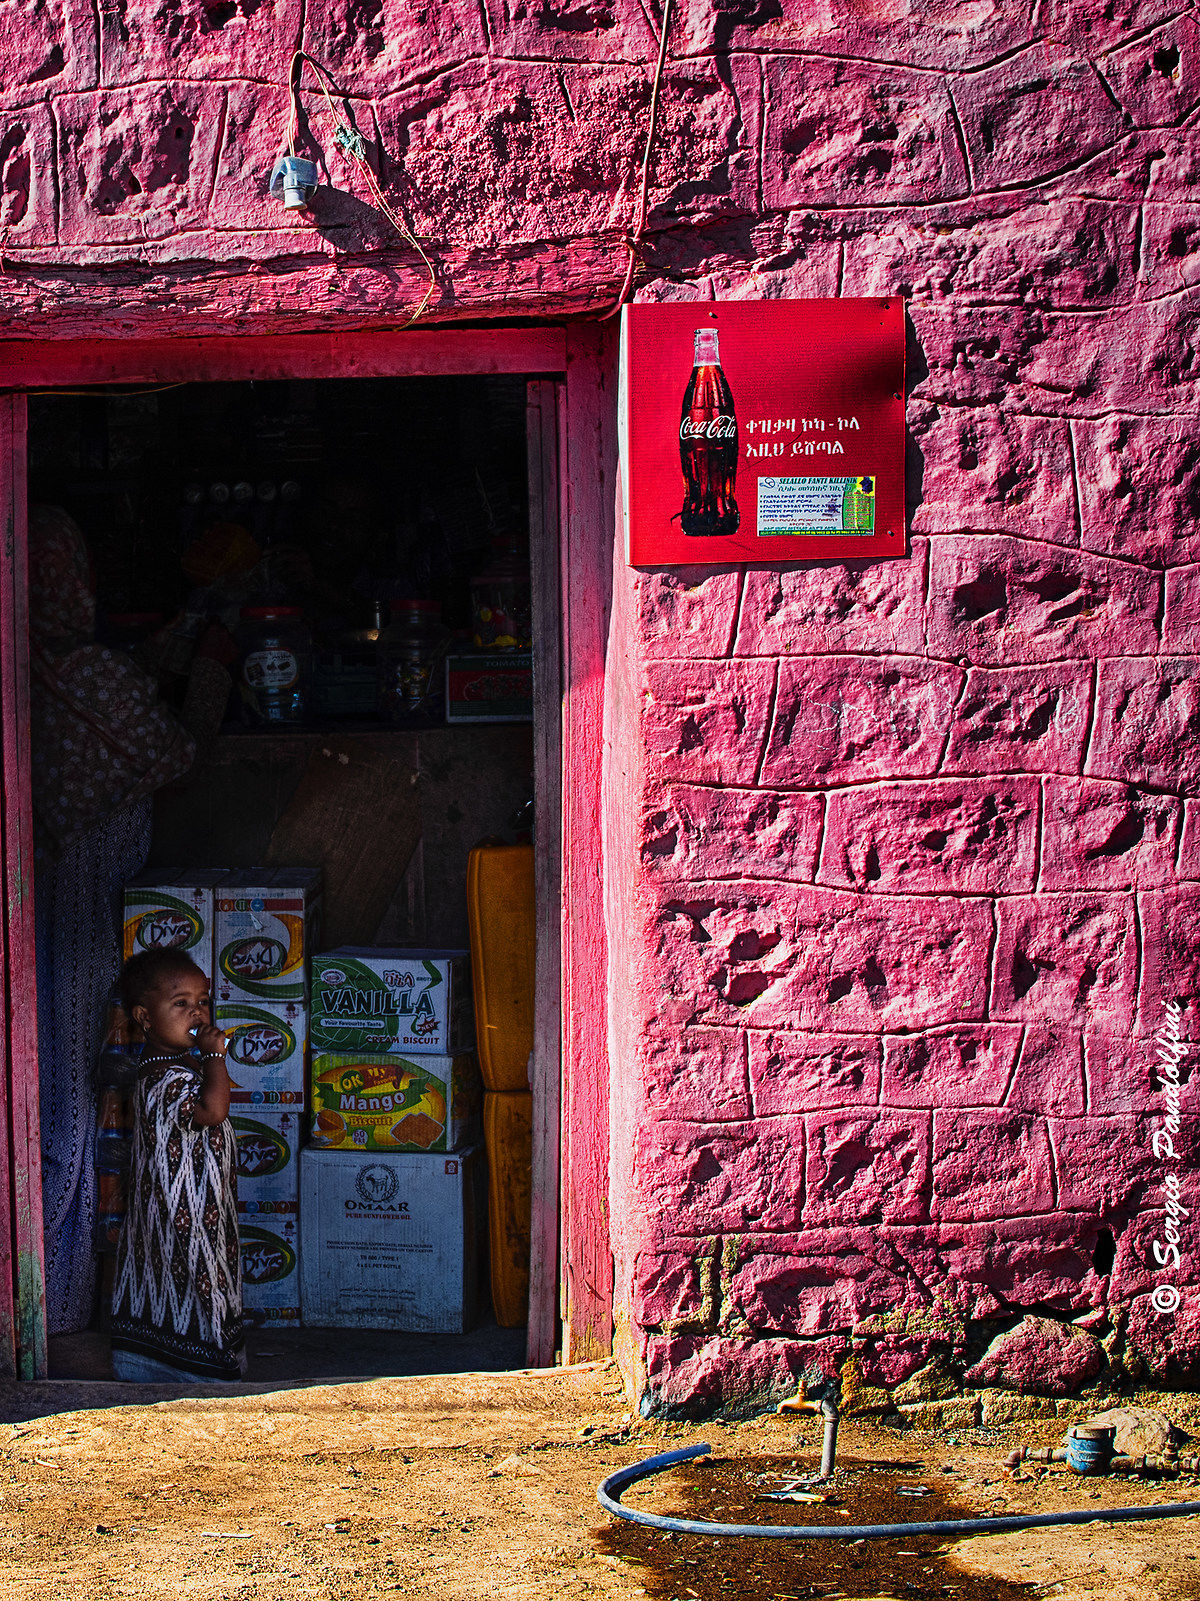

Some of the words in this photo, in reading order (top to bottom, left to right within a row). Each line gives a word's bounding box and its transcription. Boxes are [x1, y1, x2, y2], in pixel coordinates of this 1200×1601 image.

[679, 415, 737, 440] Coca-Cola
[745, 418, 796, 435] ቀዝቃዛ
[801, 417, 825, 432] ኮካ
[837, 416, 861, 431] ኮላ
[745, 442, 785, 458] እዚህ
[790, 440, 845, 458] ይሸጣል
[321, 988, 435, 1018] VANILLA
[342, 1074, 364, 1090] OK
[339, 1091, 406, 1112] Mango
[349, 1115, 393, 1126] Biscuit
[344, 1200, 410, 1212] OMAAR
